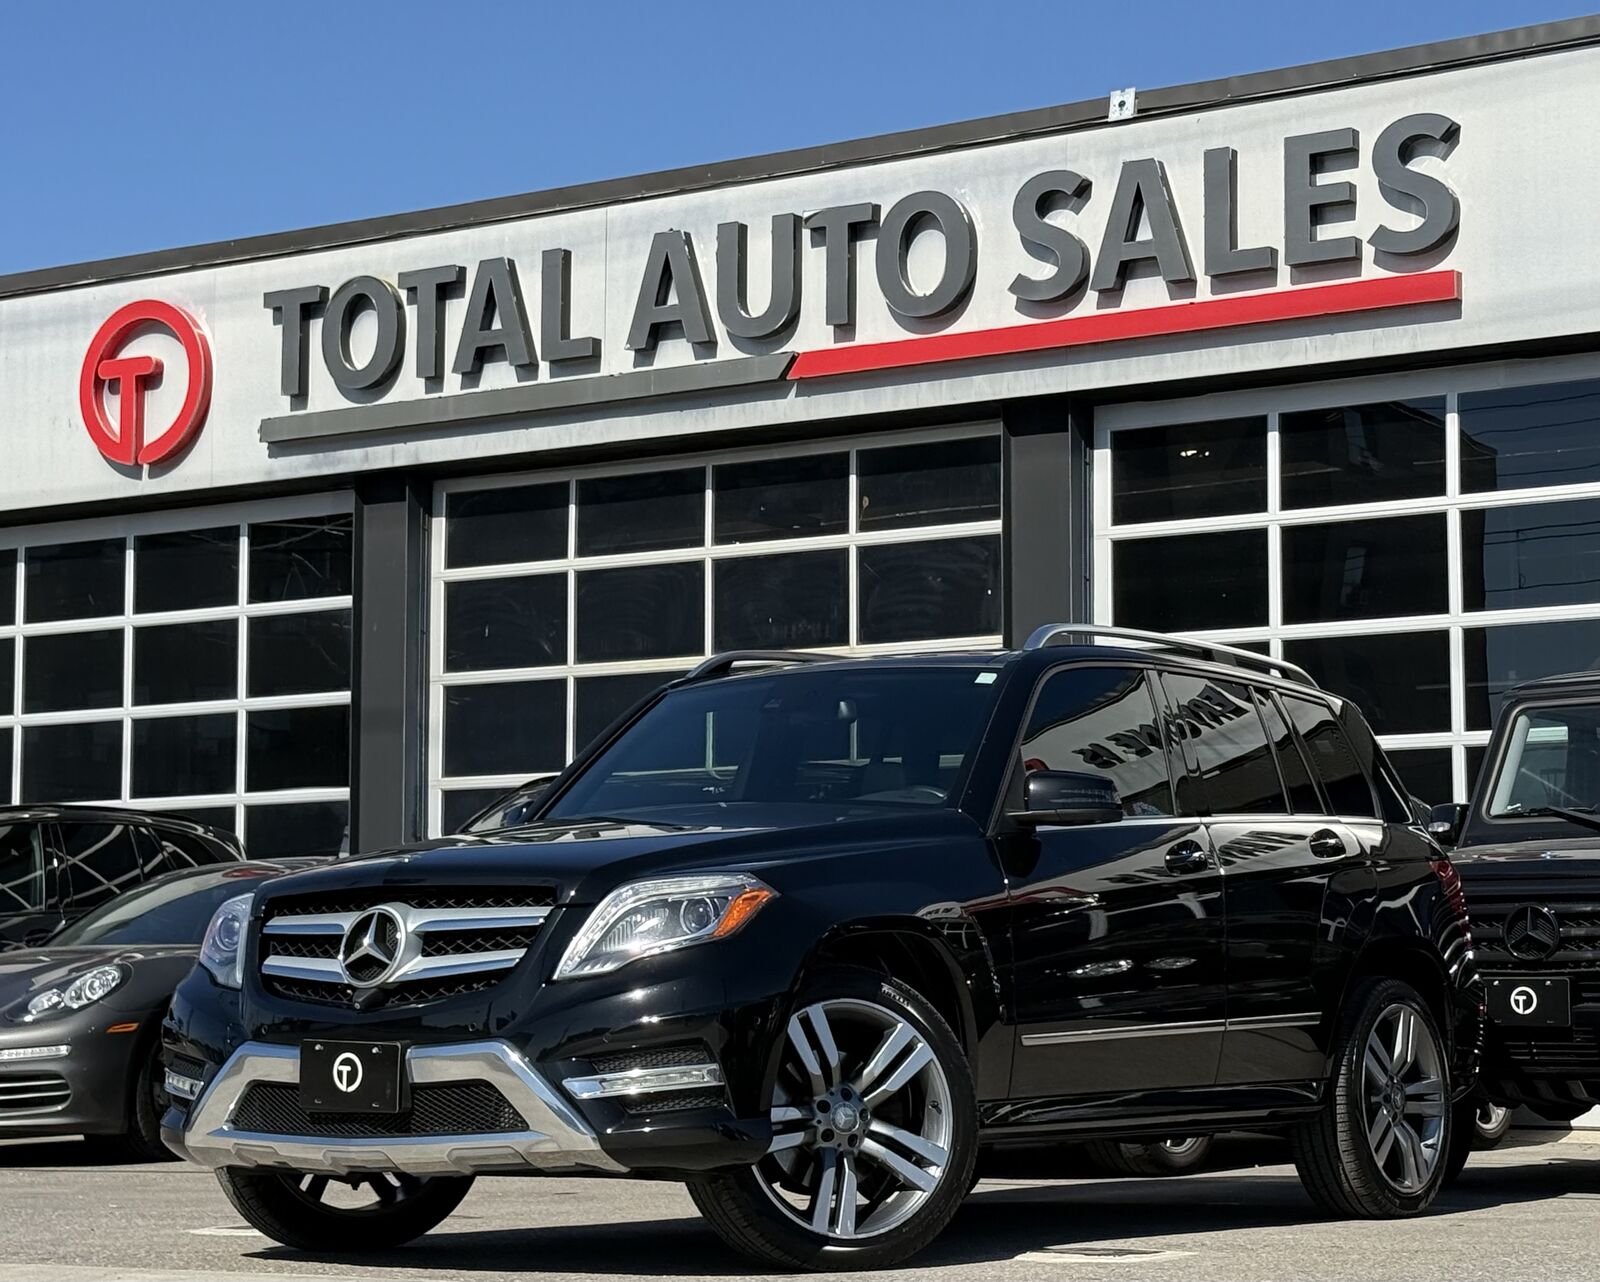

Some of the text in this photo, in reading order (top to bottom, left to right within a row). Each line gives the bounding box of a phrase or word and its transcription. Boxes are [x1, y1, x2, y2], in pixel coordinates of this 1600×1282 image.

[263, 113, 1462, 397] TOTAL AUTO SALES
